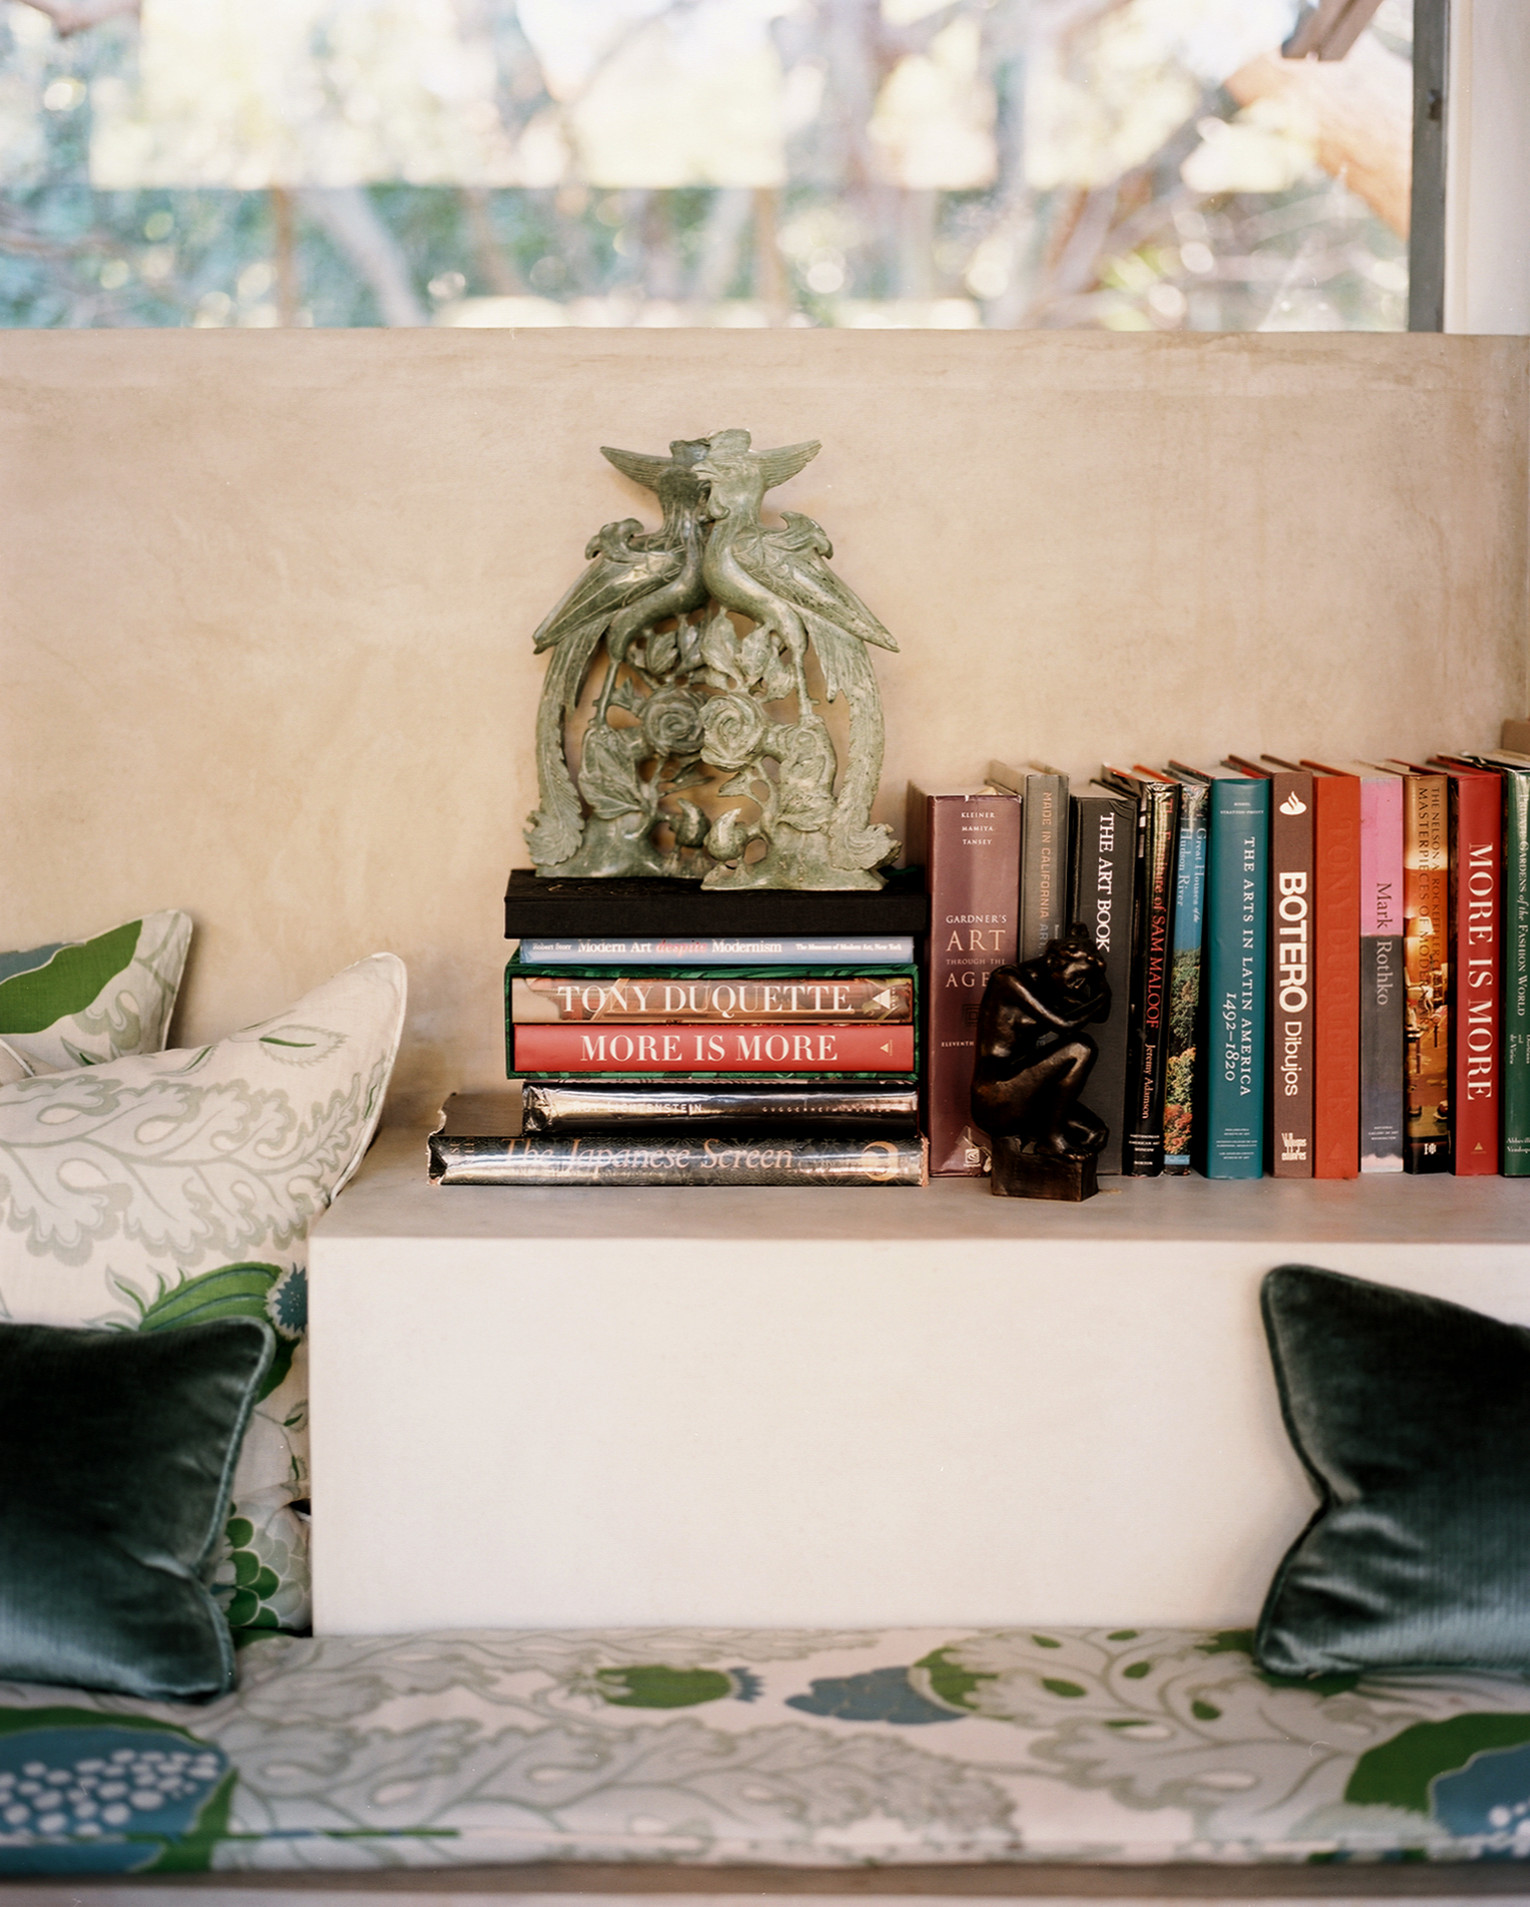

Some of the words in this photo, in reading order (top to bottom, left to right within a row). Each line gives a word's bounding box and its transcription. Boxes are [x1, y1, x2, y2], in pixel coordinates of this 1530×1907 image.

[1042, 792, 1053, 826] MADE
[1431, 788, 1441, 808] THE
[1042, 831, 1052, 843] IN
[1099, 812, 1115, 853] THE
[1179, 827, 1193, 871] Hudson
[1195, 827, 1207, 861] Great
[1419, 787, 1430, 901] MASTERPIECES
[1431, 811, 1441, 860] NELSON
[1154, 829, 1172, 893] Furniture
[1243, 836, 1256, 872] THE
[1518, 841, 1530, 893] GARDENS
[1040, 847, 1052, 919] CALIFORNIA
[1098, 857, 1113, 895] ART
[1177, 875, 1191, 907] River
[1194, 864, 1205, 905] Houses
[1468, 842, 1494, 945] MORE
[946, 915, 1007, 924] GARDNER'S
[1153, 897, 1167, 912] of
[1243, 878, 1255, 922] ARTS
[1376, 882, 1393, 929] Mark
[1419, 905, 1430, 923] OF
[1516, 895, 1529, 907] of
[1518, 906, 1529, 921] the
[945, 930, 1007, 952] ART
[1096, 899, 1111, 953] BOOK
[1150, 916, 1167, 952] SAM
[1242, 929, 1254, 949] IN
[1279, 871, 1308, 1013] BOTERO
[578, 940, 627, 953] Modern
[630, 941, 652, 953] Art
[656, 940, 708, 958] despite
[712, 940, 783, 953] Modernism
[1518, 924, 1529, 972] FASHION
[945, 972, 990, 988] AGE
[1146, 957, 1164, 1029] MALOOF
[1241, 957, 1253, 1011] LATIN
[1376, 940, 1393, 1006] Rothko
[1467, 957, 1494, 989] IS
[557, 985, 659, 1013] TONY
[665, 985, 853, 1019] DUQUETTE
[1517, 974, 1528, 1016] WORLD
[580, 1034, 683, 1062] MORE
[694, 1034, 726, 1062] IS
[736, 1034, 839, 1062] MORE
[941, 1040, 975, 1048] ELEVENTH
[1143, 1043, 1156, 1075] Jeremy
[1240, 1017, 1252, 1096] AMERICA
[1281, 1021, 1303, 1097] Dibujos
[1466, 999, 1493, 1100] MORE
[1142, 1077, 1154, 1119] Adamson
[502, 1138, 554, 1165] The
[568, 1138, 690, 1181] Japanese
[700, 1138, 794, 1169] Screen
